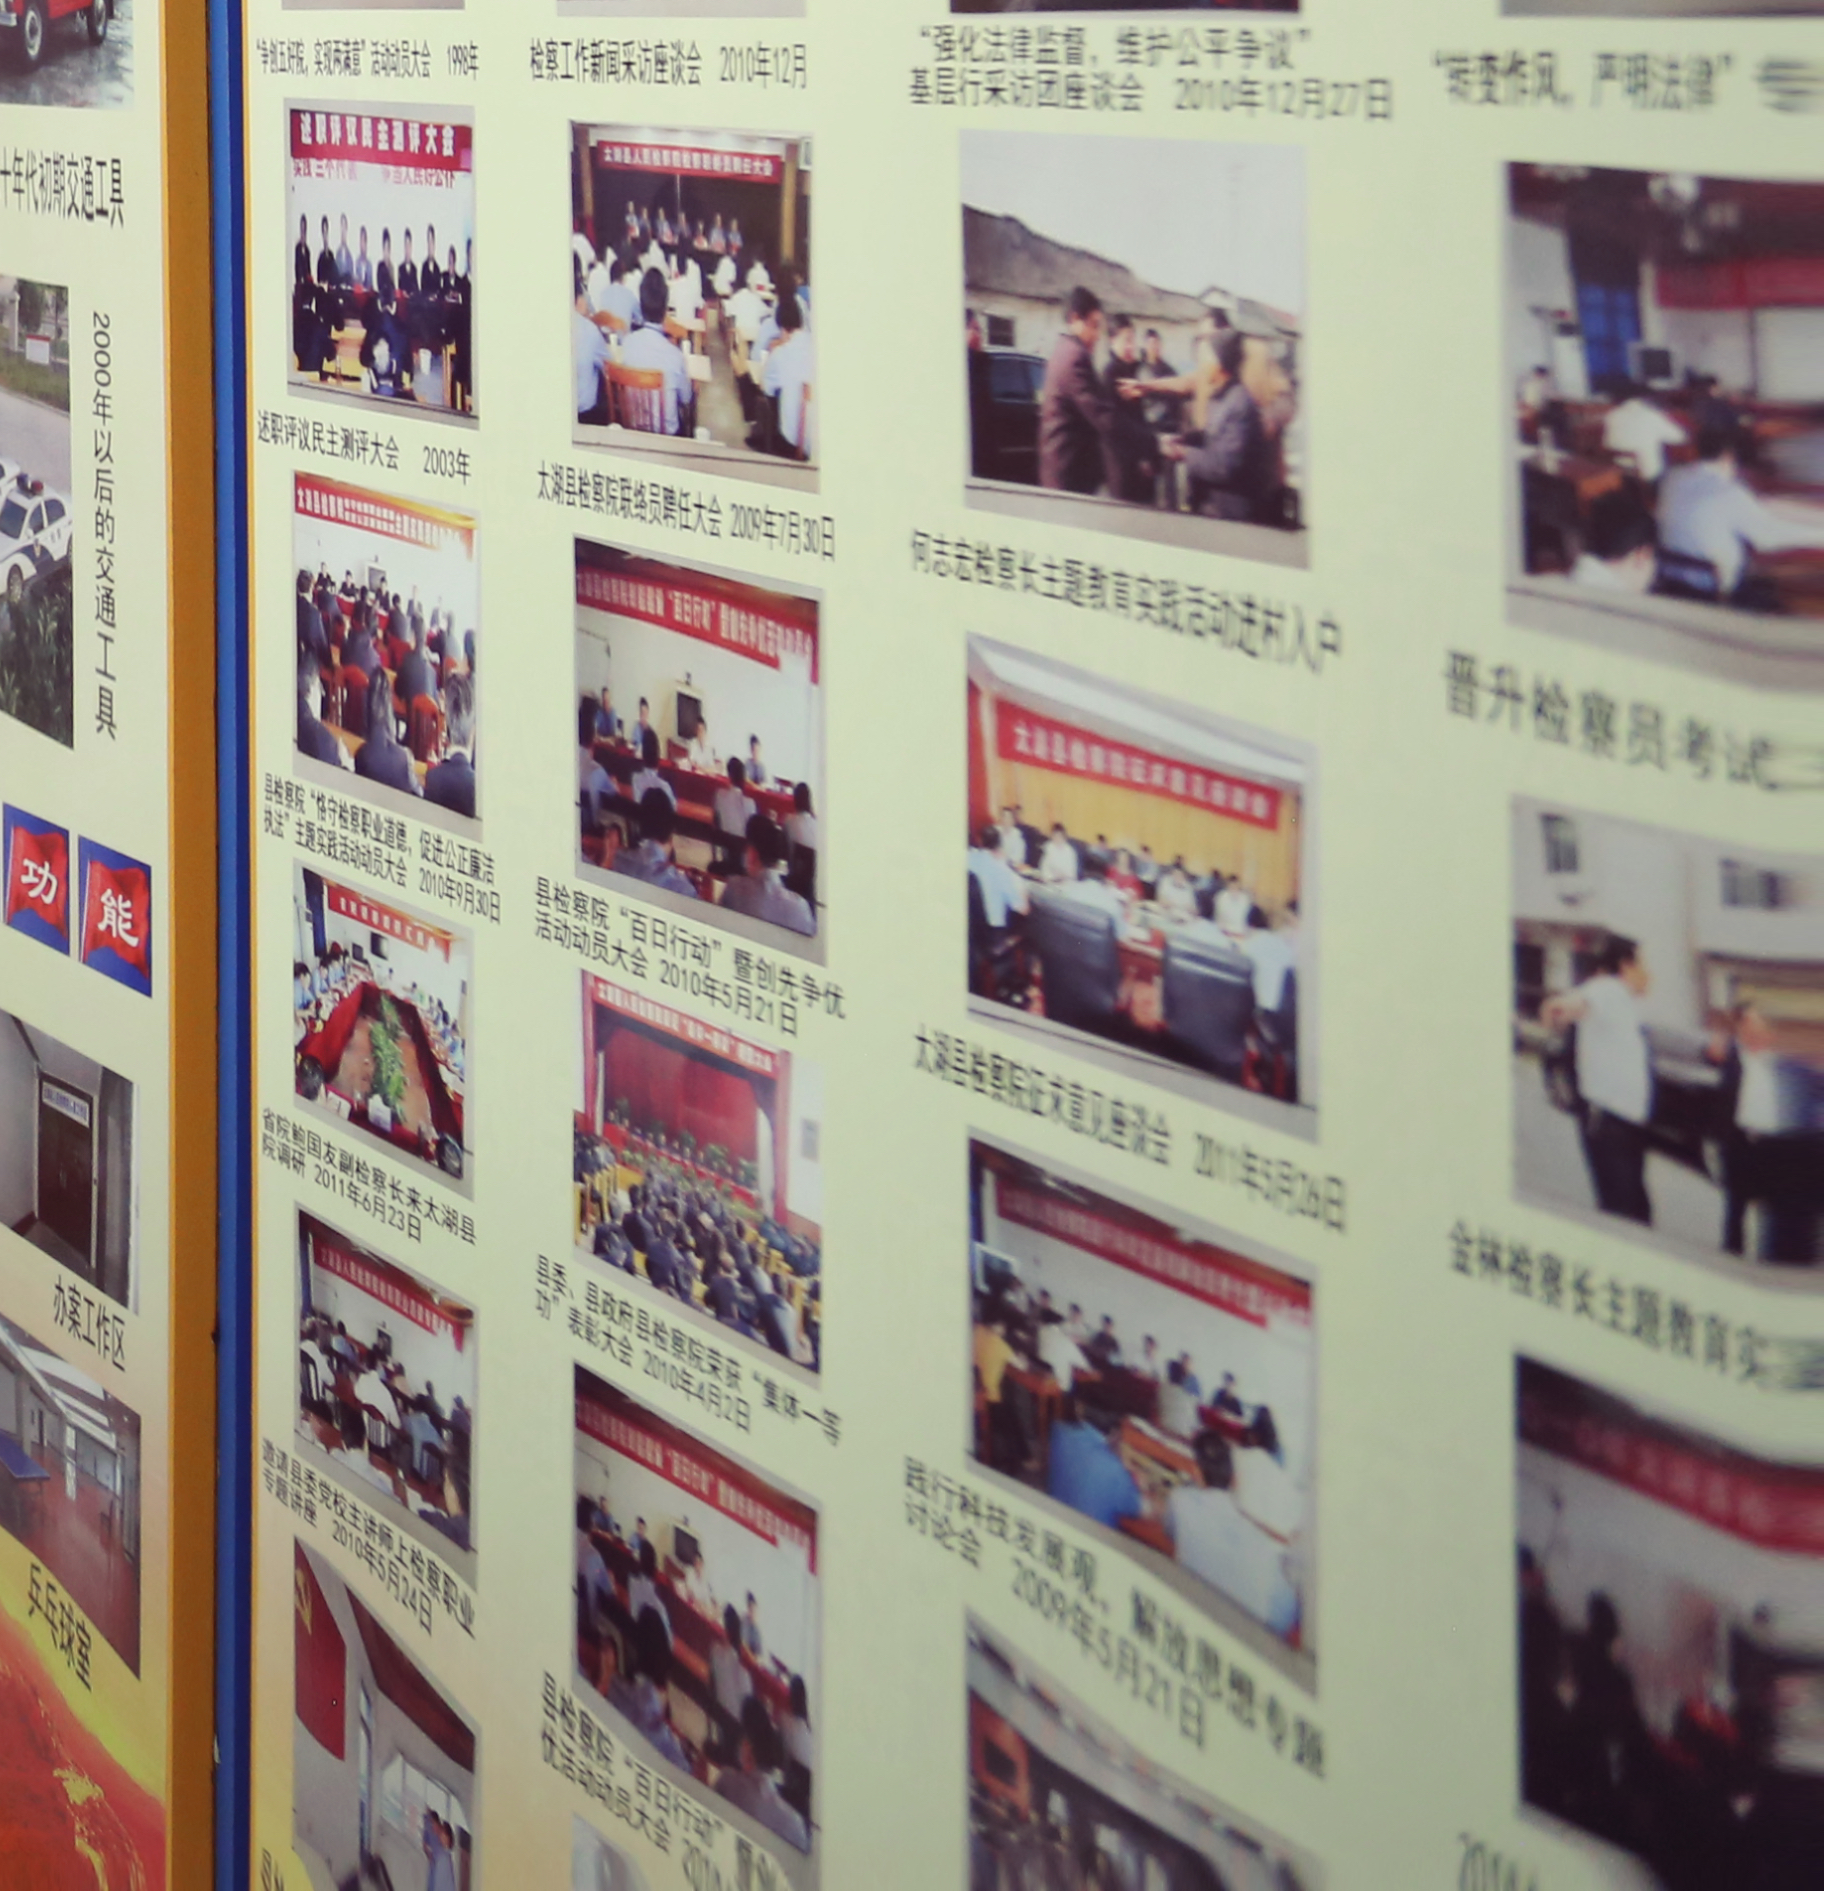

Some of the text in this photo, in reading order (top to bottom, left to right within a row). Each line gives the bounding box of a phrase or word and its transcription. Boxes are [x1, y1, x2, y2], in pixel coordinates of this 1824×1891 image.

[530, 37, 703, 89] 检察工作新闻采访座谈会
[256, 408, 473, 487] 述职评议民主测评大会 2003年
[91, 310, 118, 742] 2000年以后的交通工具
[534, 912, 650, 982] 活动动员大会
[659, 951, 800, 1040] 2010年5月21日
[261, 1138, 423, 1246] 院调研 2011年6月23日
[51, 1274, 127, 1374] 办案工作区
[263, 1467, 434, 1640] 专题讲座 2010年5月24日
[26, 1562, 93, 1694] 乒乓球室
